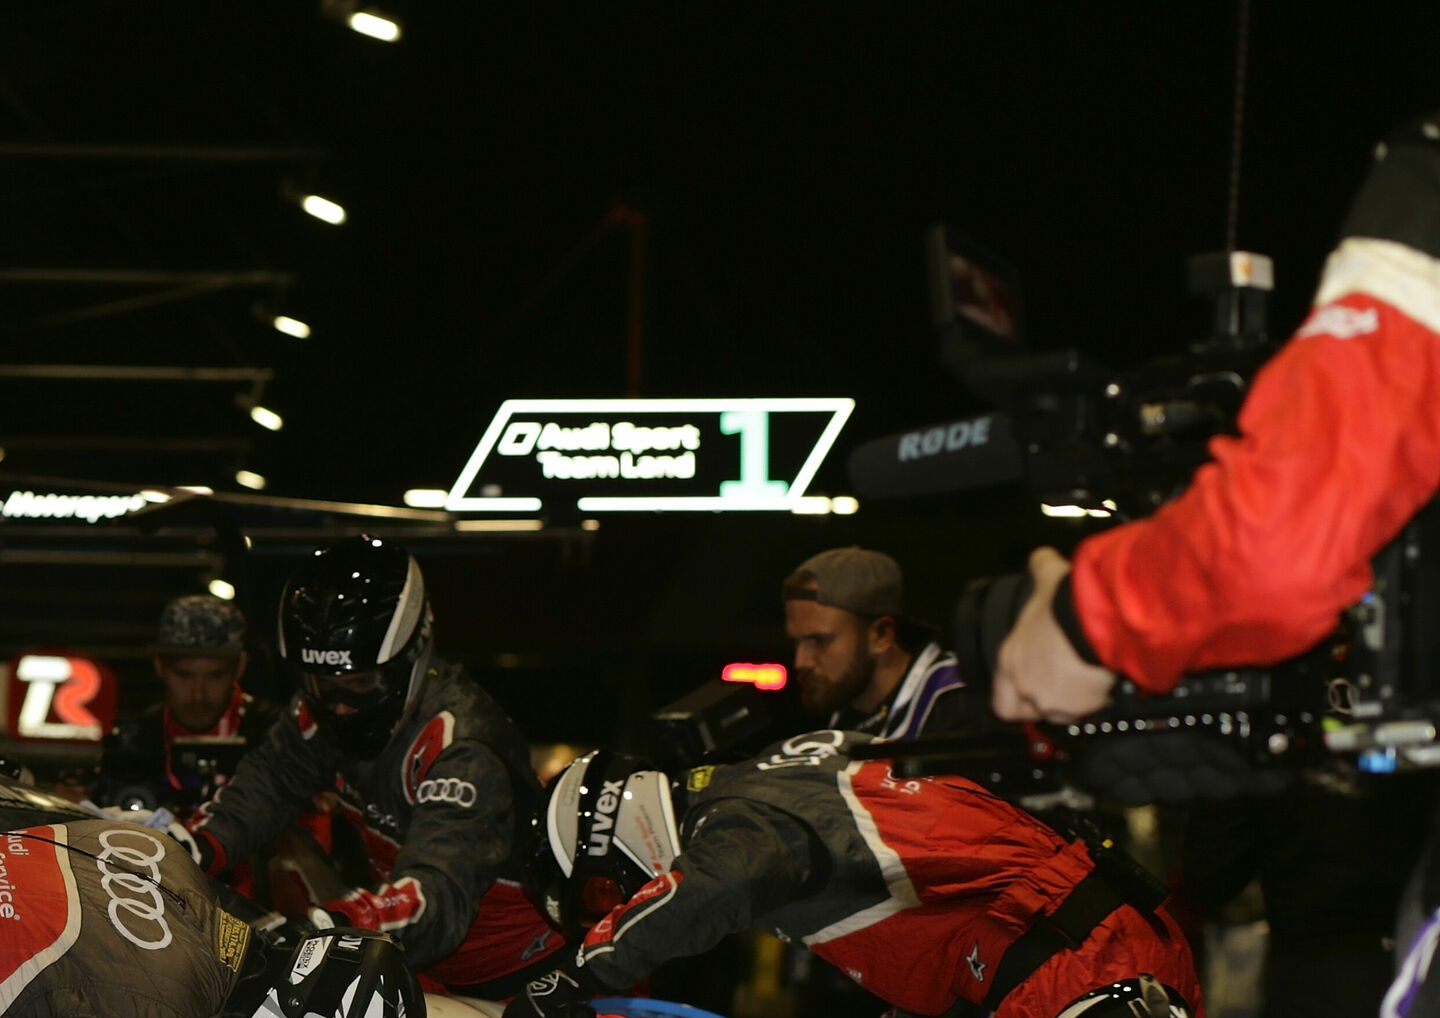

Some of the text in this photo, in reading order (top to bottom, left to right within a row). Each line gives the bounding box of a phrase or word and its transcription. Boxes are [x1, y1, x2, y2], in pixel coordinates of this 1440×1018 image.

[537, 421, 700, 455] Audi Sport
[720, 410, 789, 498] 1
[897, 416, 993, 462] RØDE
[537, 451, 697, 479] Team Land
[301, 646, 352, 667] uvex
[587, 778, 625, 857] uvex
